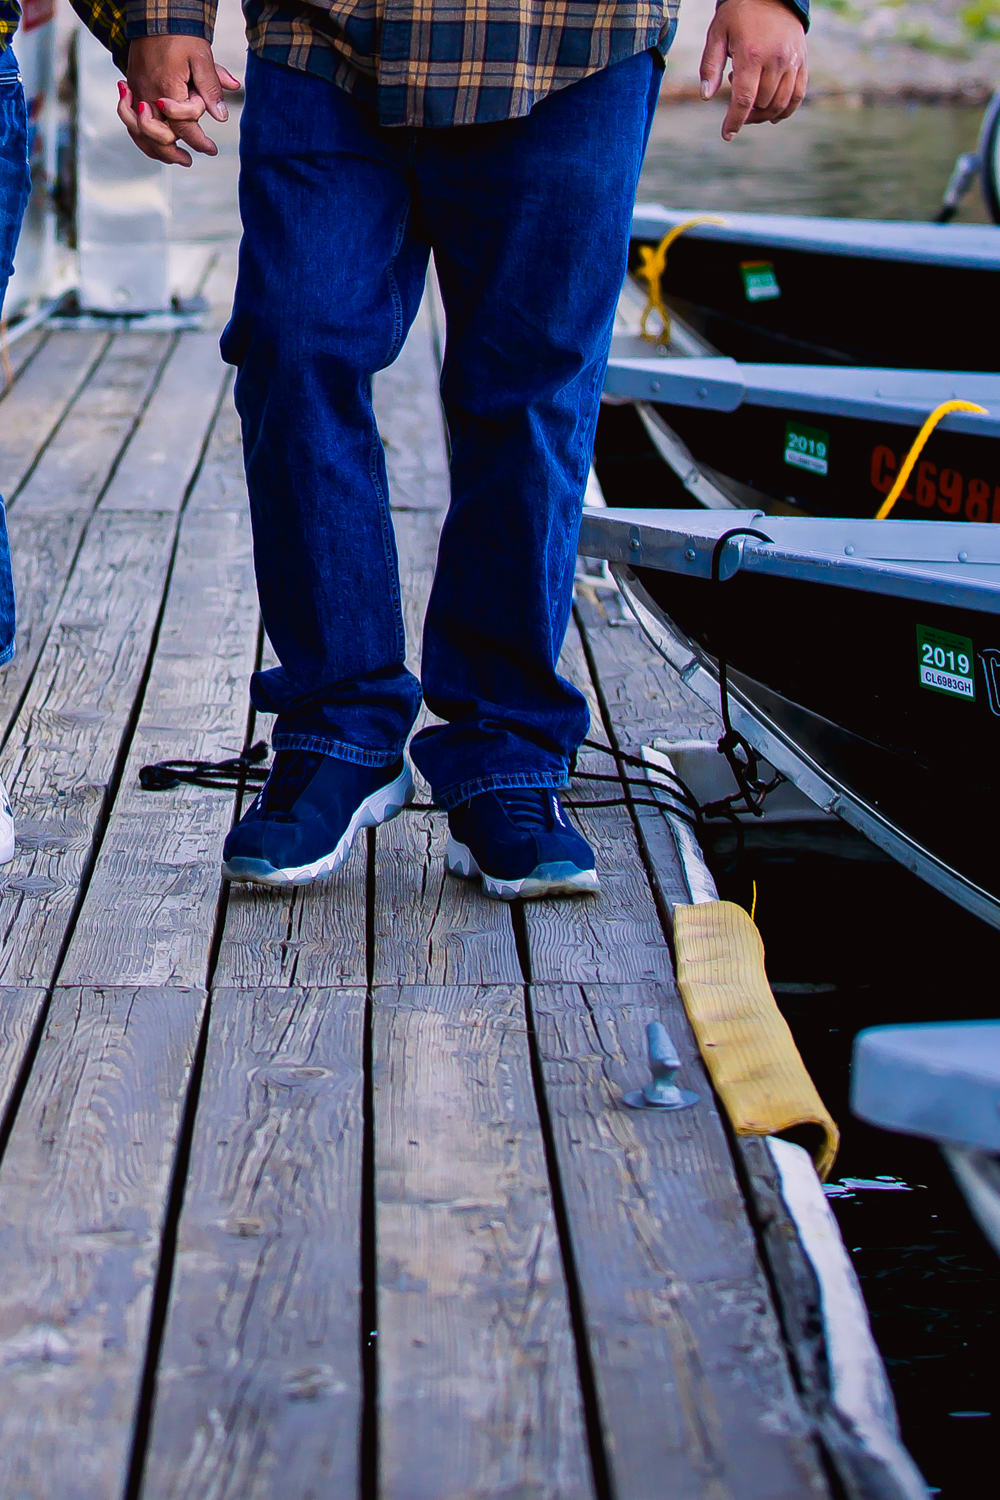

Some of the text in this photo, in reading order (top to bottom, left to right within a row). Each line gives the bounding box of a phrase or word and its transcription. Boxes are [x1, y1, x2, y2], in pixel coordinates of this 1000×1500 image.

[788, 432, 827, 458] 2019
[921, 643, 970, 674] 2019
[925, 671, 971, 693] CL6983GH
